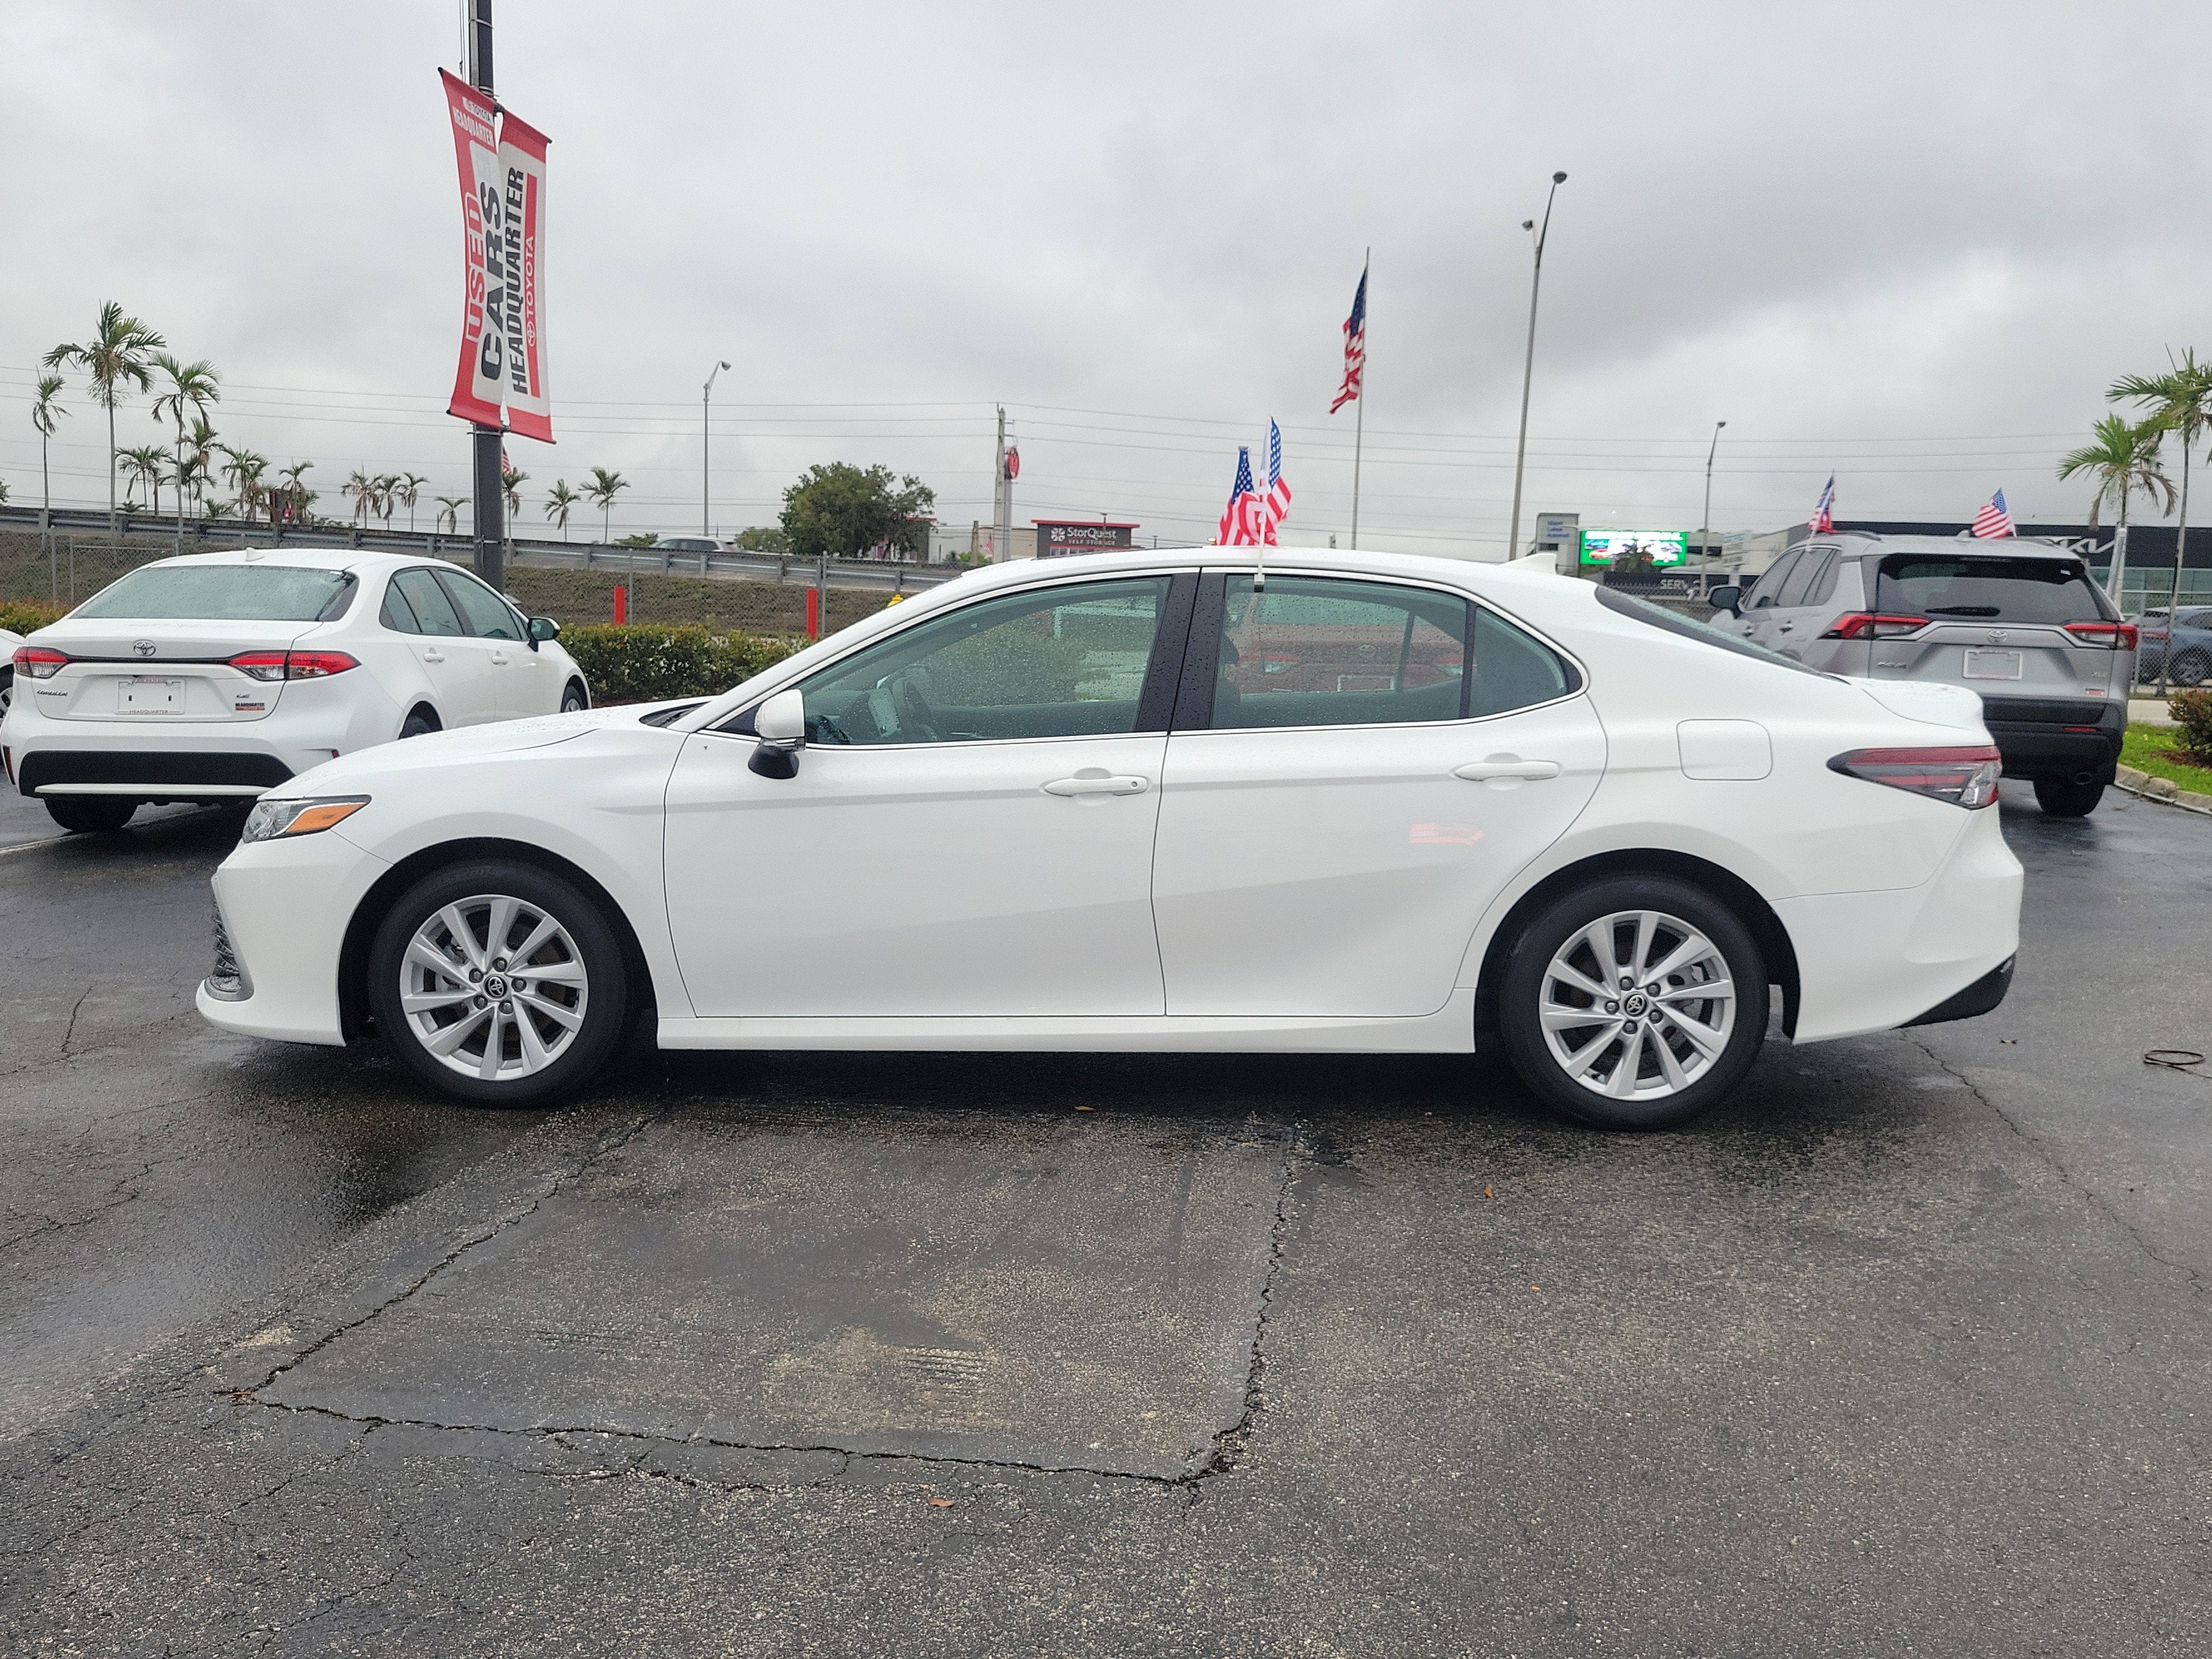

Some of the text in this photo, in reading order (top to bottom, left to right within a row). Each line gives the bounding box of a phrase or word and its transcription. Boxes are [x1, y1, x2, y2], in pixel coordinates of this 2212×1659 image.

[453, 105, 494, 148] HEADQUARTER
[467, 193, 485, 342] USED
[481, 182, 503, 381] CARS
[505, 167, 528, 394] HEADQUARTER
[525, 236, 534, 318] TOYOTA
